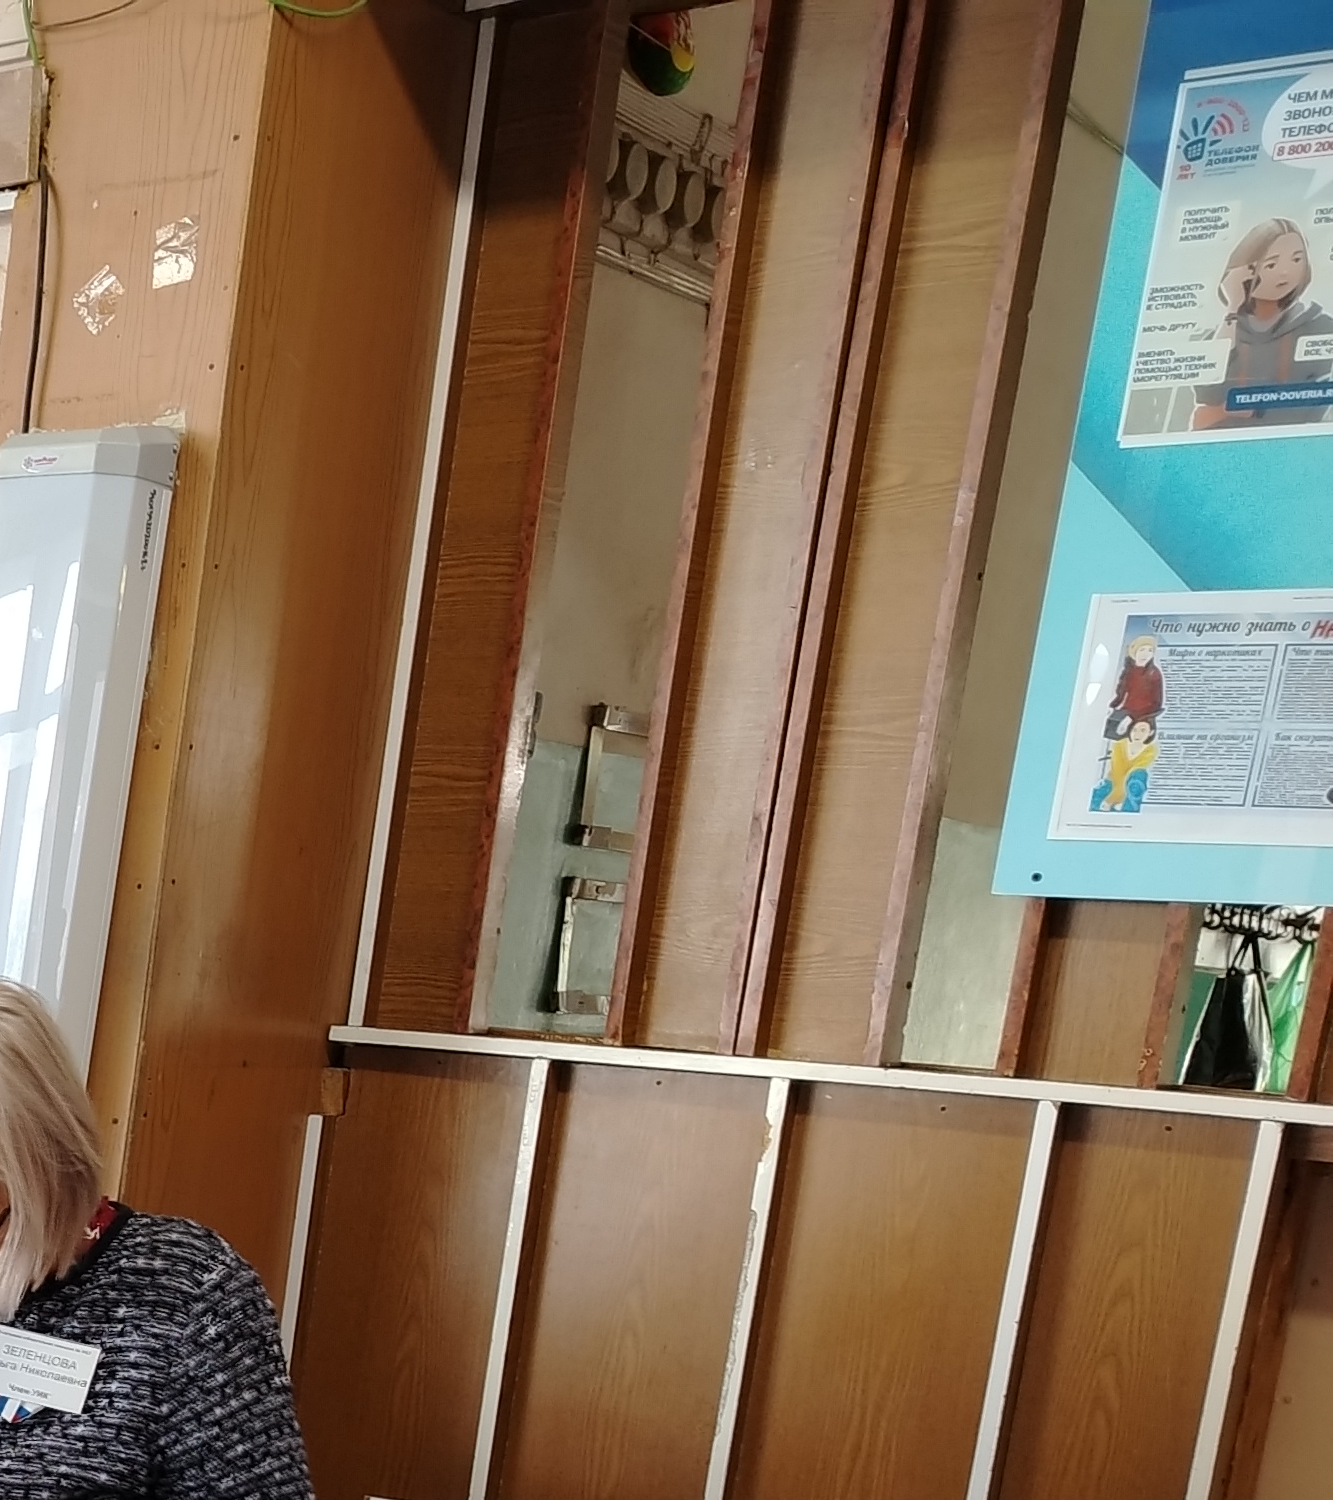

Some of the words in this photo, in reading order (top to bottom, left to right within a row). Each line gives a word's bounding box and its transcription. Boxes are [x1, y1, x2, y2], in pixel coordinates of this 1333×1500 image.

[1288, 90, 1318, 103] ЧЕМ
[1283, 105, 1333, 121] ЗВОНО
[1277, 146, 1285, 156] 8
[1287, 143, 1312, 155] 800
[1204, 154, 1258, 167] ДОВЕРИЯ
[1183, 206, 1231, 217] ПОЛУЧИТЬ
[1182, 215, 1223, 225] ПОМОЩЬ
[1188, 221, 1230, 233] НУЖНЫЙ
[1179, 232, 1217, 242] МОМЕНТ
[1150, 618, 1183, 633] Что
[1186, 620, 1242, 637] нужно
[1245, 620, 1297, 636] знать
[1301, 621, 1311, 632] о
[2, 1344, 78, 1372] ЗЕЛЕНЦОВА
[20, 1362, 87, 1389] Николаевна
